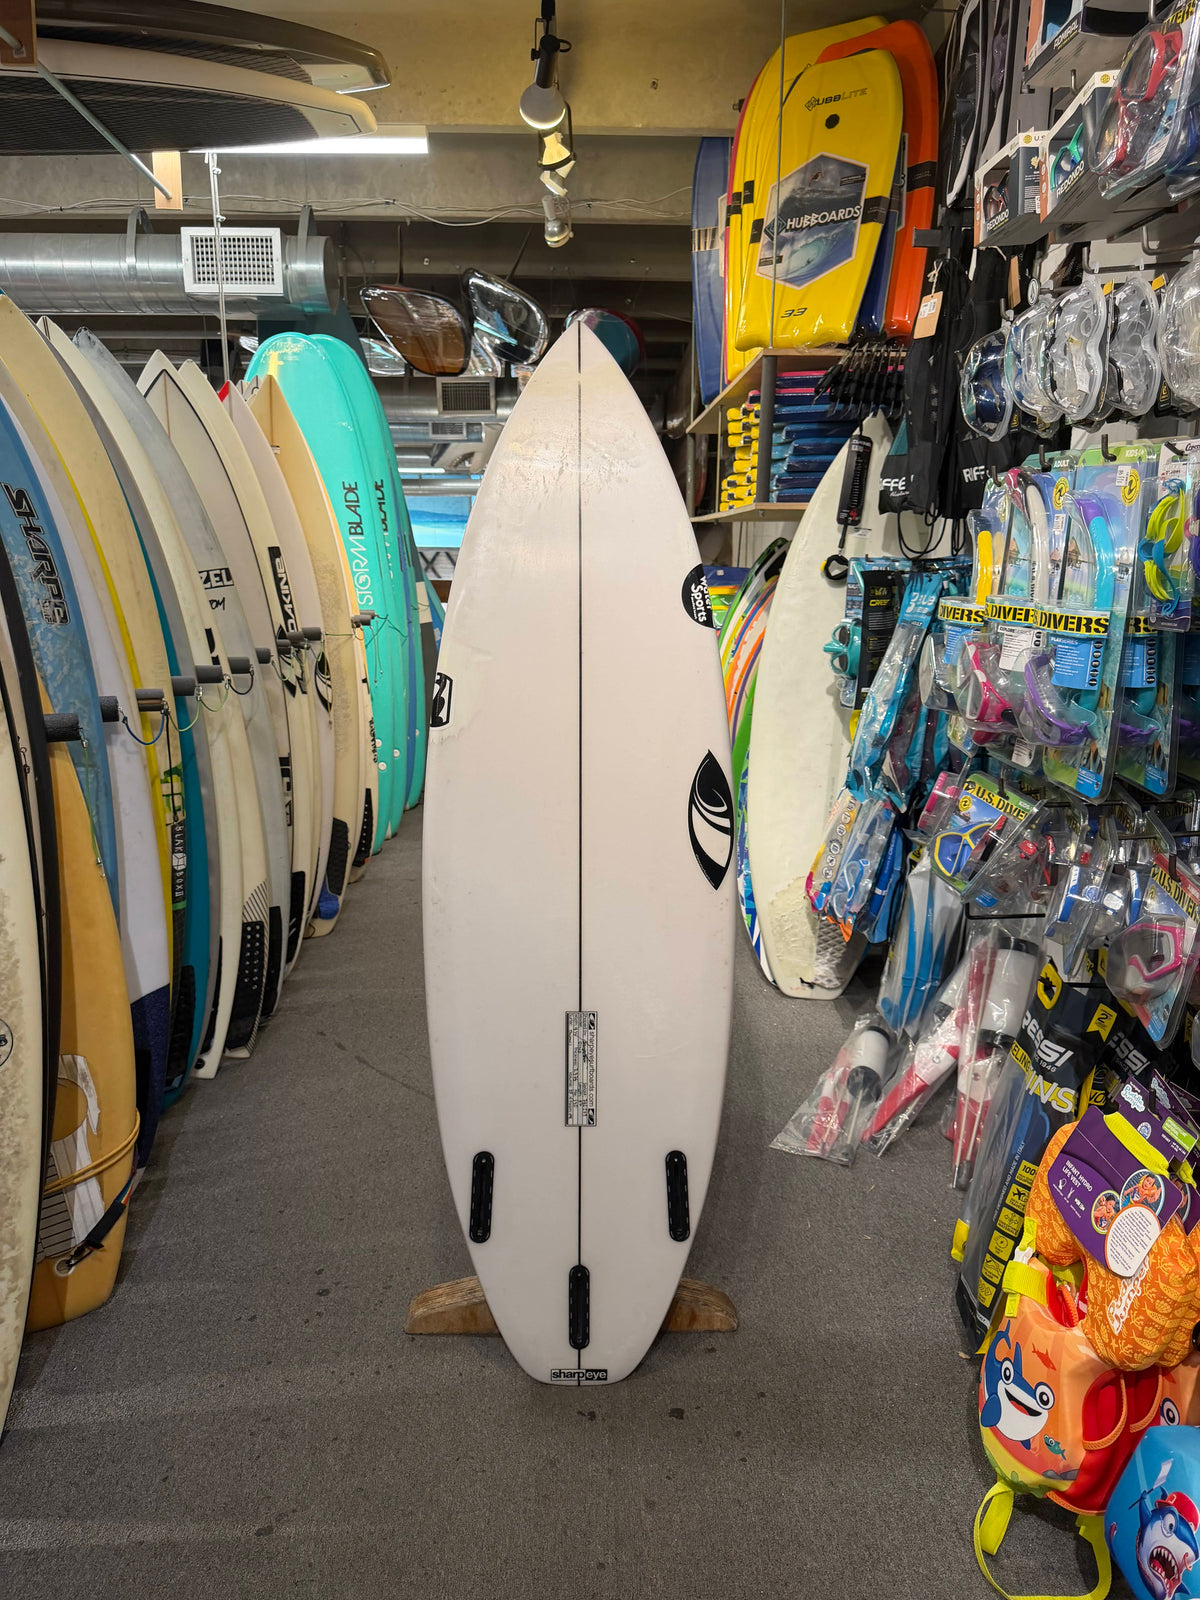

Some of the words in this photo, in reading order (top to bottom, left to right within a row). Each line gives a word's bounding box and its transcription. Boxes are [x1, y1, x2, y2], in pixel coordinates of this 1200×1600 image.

[1053, 20, 1079, 49] ADMIRAL
[1056, 161, 1085, 199] REDONDO
[786, 205, 862, 230] HUBBOARDS
[986, 209, 1010, 232] REDONDO
[781, 307, 808, 319] 33
[962, 465, 986, 483] RIFF
[1053, 459, 1070, 468] ADULT
[881, 476, 906, 492] FFE
[201, 568, 233, 589] ZEL
[275, 556, 298, 633] DAKINE
[690, 583, 707, 622] Sports
[700, 576, 713, 610] water
[940, 604, 985, 623] DIVERS
[990, 604, 1034, 623] DIVER
[1040, 611, 1109, 634] DIVERS
[976, 786, 995, 806] U.S.
[996, 797, 1028, 821] DIVE
[175, 825, 184, 851] BLAK
[1021, 1010, 1074, 1068] RESSI
[588, 1031, 596, 1107] sharpeyesurfboards.com
[1012, 1044, 1033, 1072] ELING
[1026, 1067, 1076, 1113] INS
[1016, 1140, 1027, 1155] ITALY
[1022, 1164, 1037, 1177] 100
[1062, 1166, 1072, 1179] LIFE
[1070, 1174, 1082, 1188] VEST
[1065, 1160, 1081, 1178] INFANT
[1078, 1174, 1093, 1192] HYDRO
[552, 1370, 607, 1380] sharpeye
